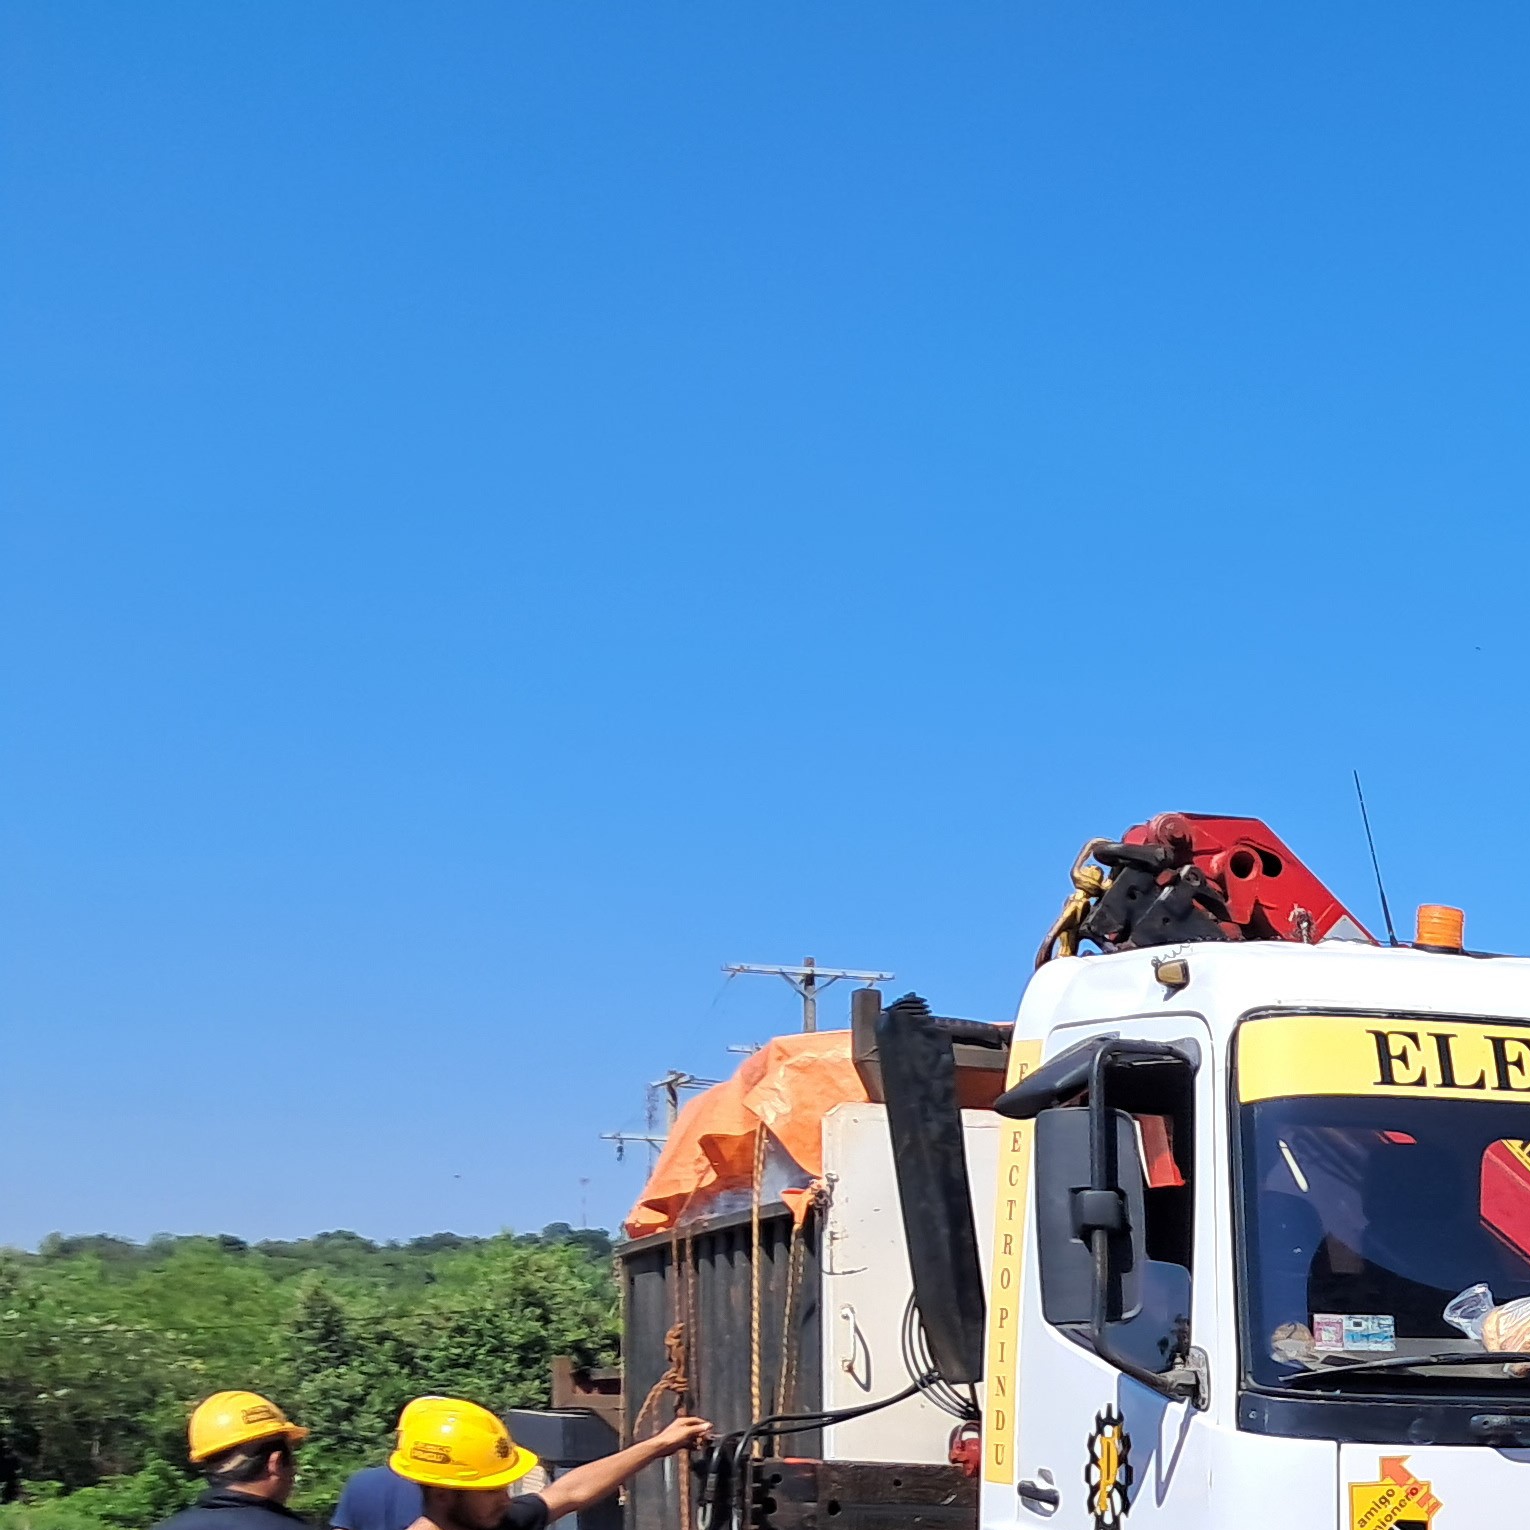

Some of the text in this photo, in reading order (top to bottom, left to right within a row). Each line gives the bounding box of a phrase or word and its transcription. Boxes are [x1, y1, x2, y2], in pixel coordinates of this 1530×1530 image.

[993, 1062, 1029, 1466] EECTRO PINDU
[1357, 1488, 1396, 1528] amigo
